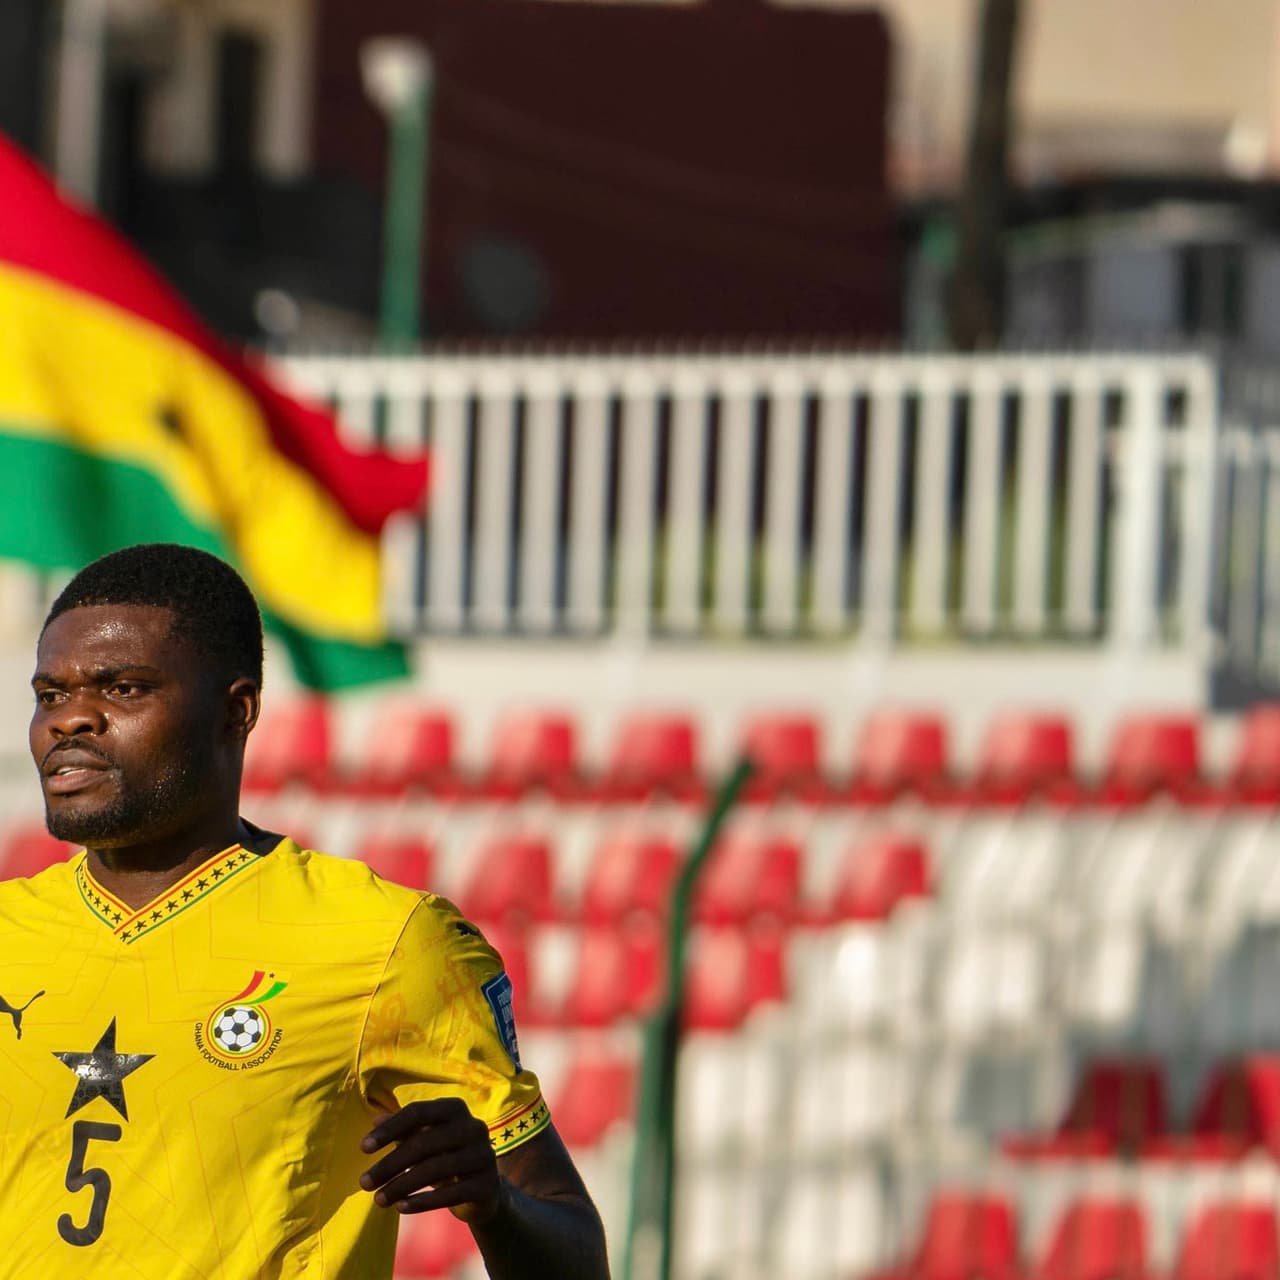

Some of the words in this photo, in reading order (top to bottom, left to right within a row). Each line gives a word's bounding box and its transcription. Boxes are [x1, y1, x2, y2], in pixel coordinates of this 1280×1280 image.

[194, 1022, 204, 1050] GHANA
[200, 1047, 240, 1071] FOOTBALL
[240, 1028, 283, 1070] ASSOCIATION
[57, 1120, 122, 1247] 5
